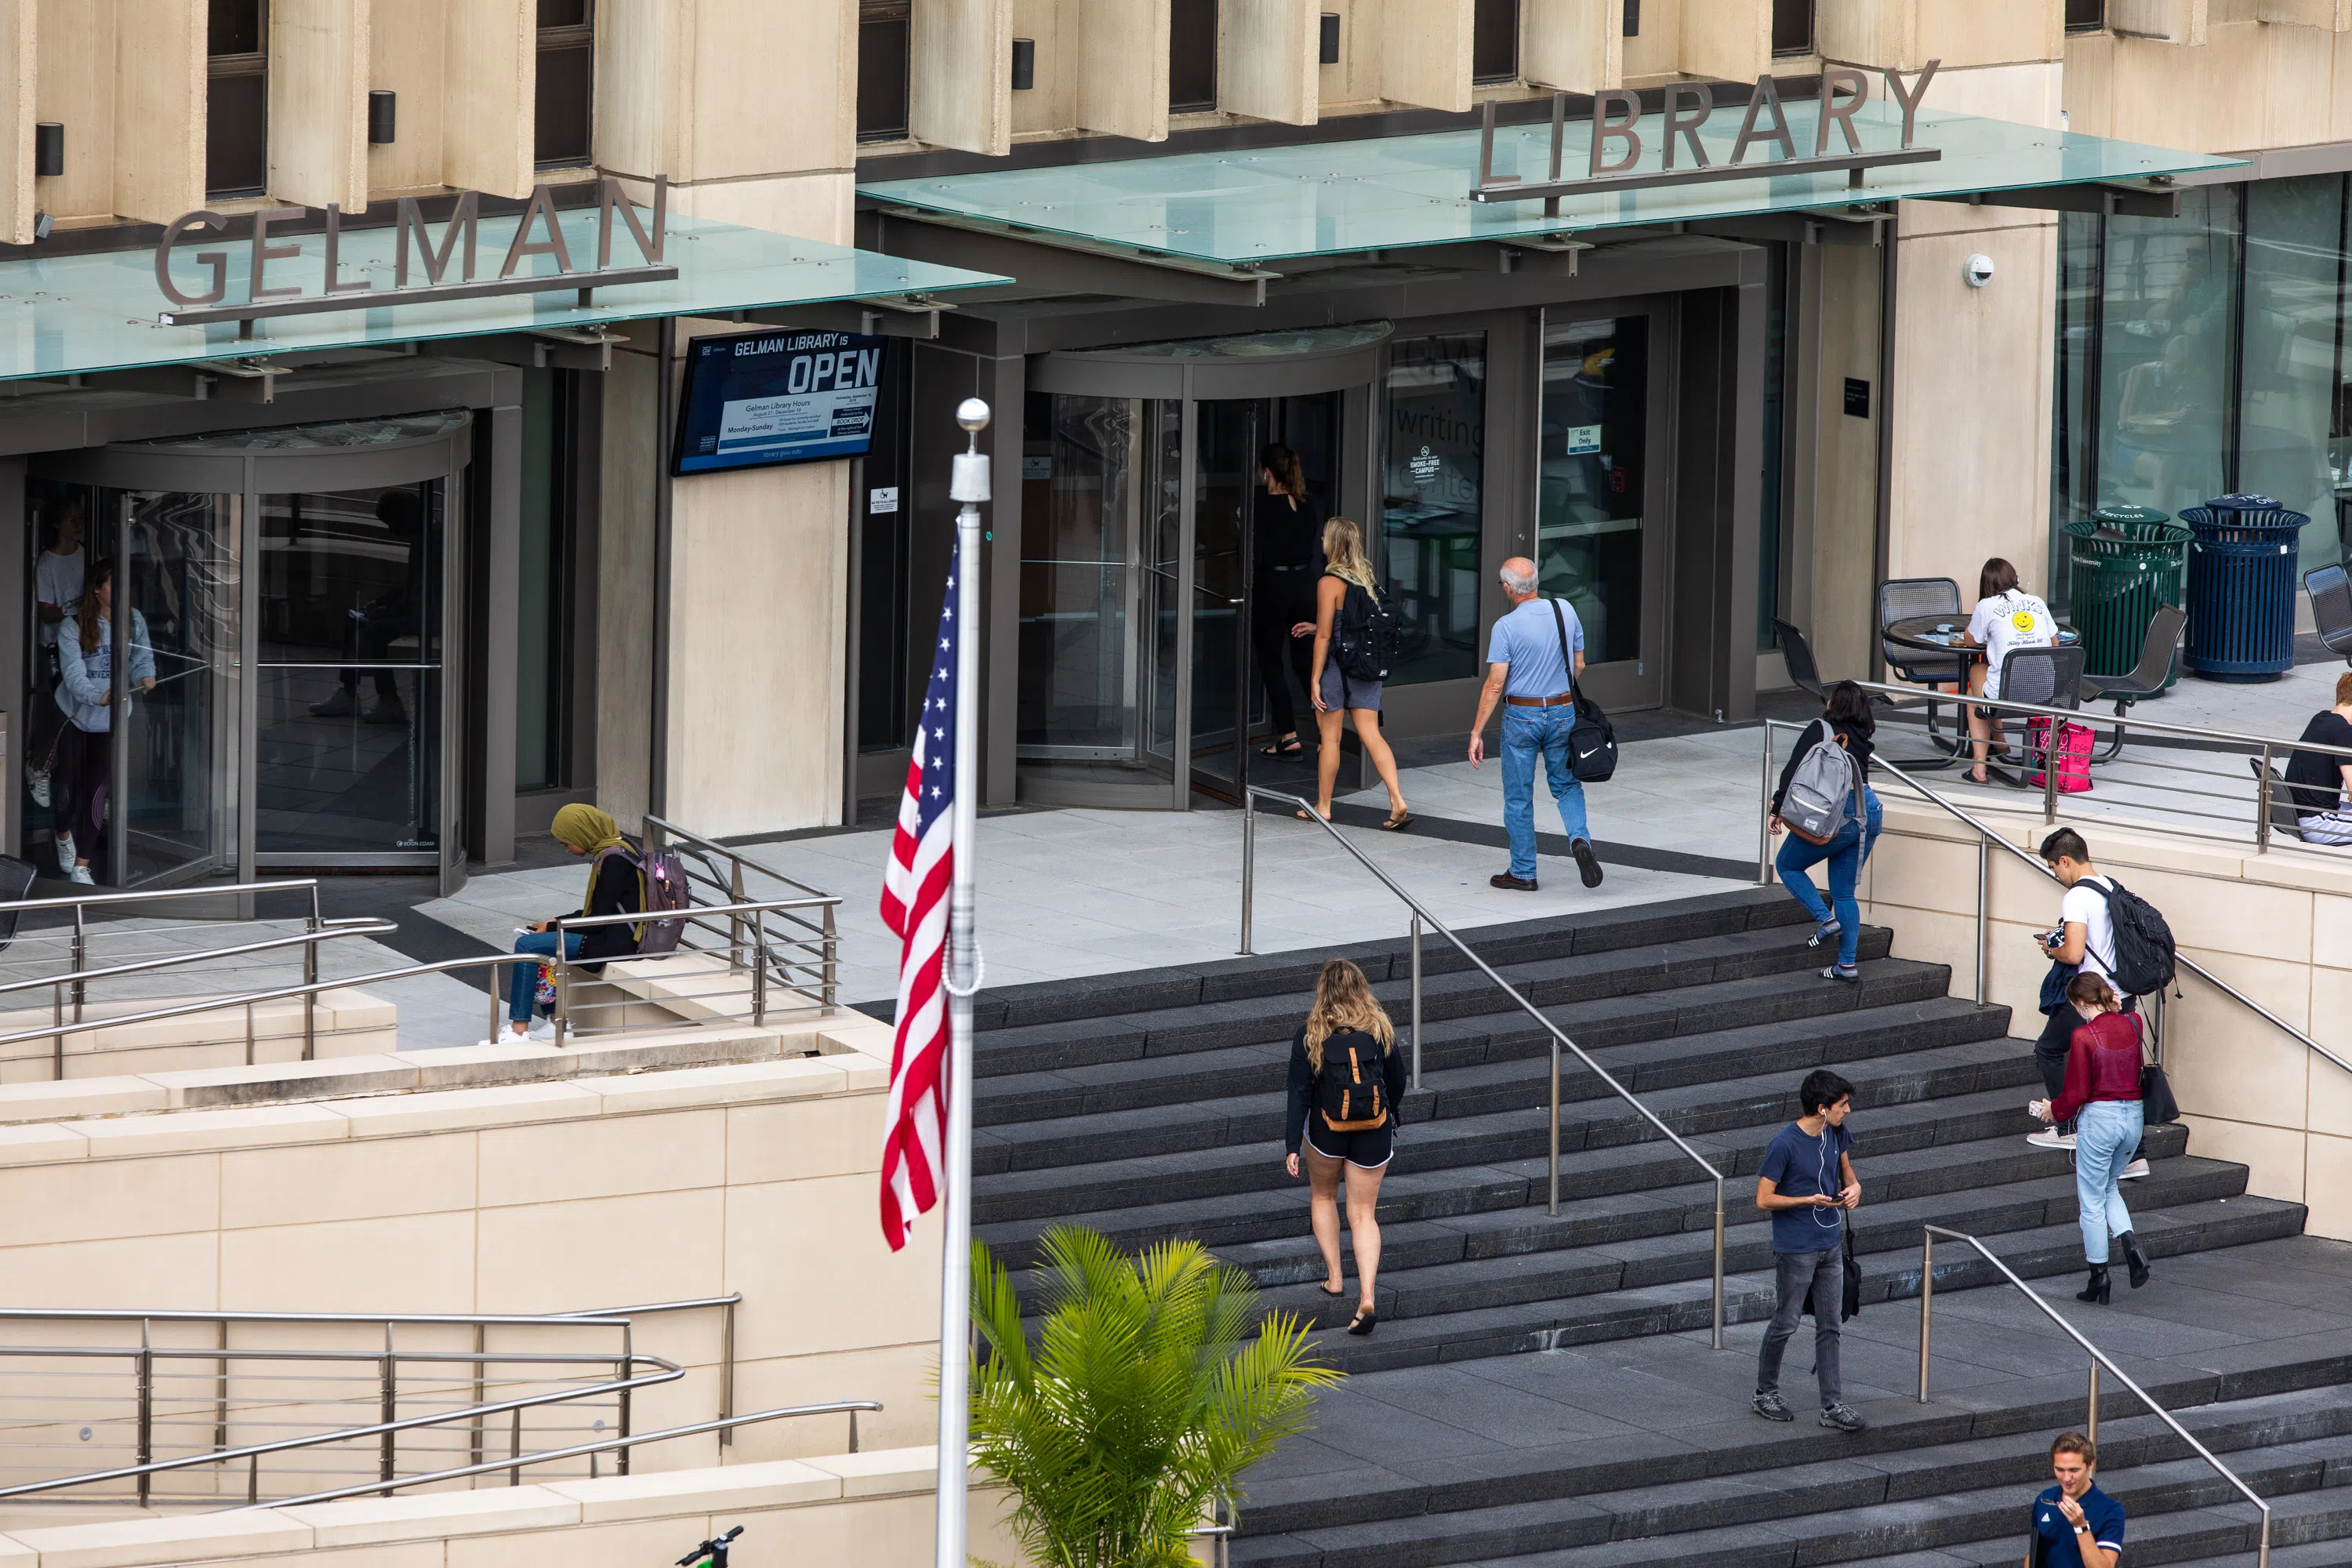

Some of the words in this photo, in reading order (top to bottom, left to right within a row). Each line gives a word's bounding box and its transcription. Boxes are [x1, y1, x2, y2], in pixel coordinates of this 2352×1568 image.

[1479, 58, 1941, 188] LIBRARY
[156, 174, 668, 307] GELMAN
[735, 338, 784, 356] GELMAN
[786, 332, 839, 351] LIBRARY
[840, 336, 848, 346] IS
[787, 348, 880, 394] OPEN
[746, 404, 769, 412] Gelman
[771, 401, 792, 411] Library
[728, 423, 773, 434] Monday-Sunday
[1410, 459, 1440, 468] SMOKE-FREE
[2079, 557, 2102, 568] University
[86, 670, 111, 679] UNIVER
